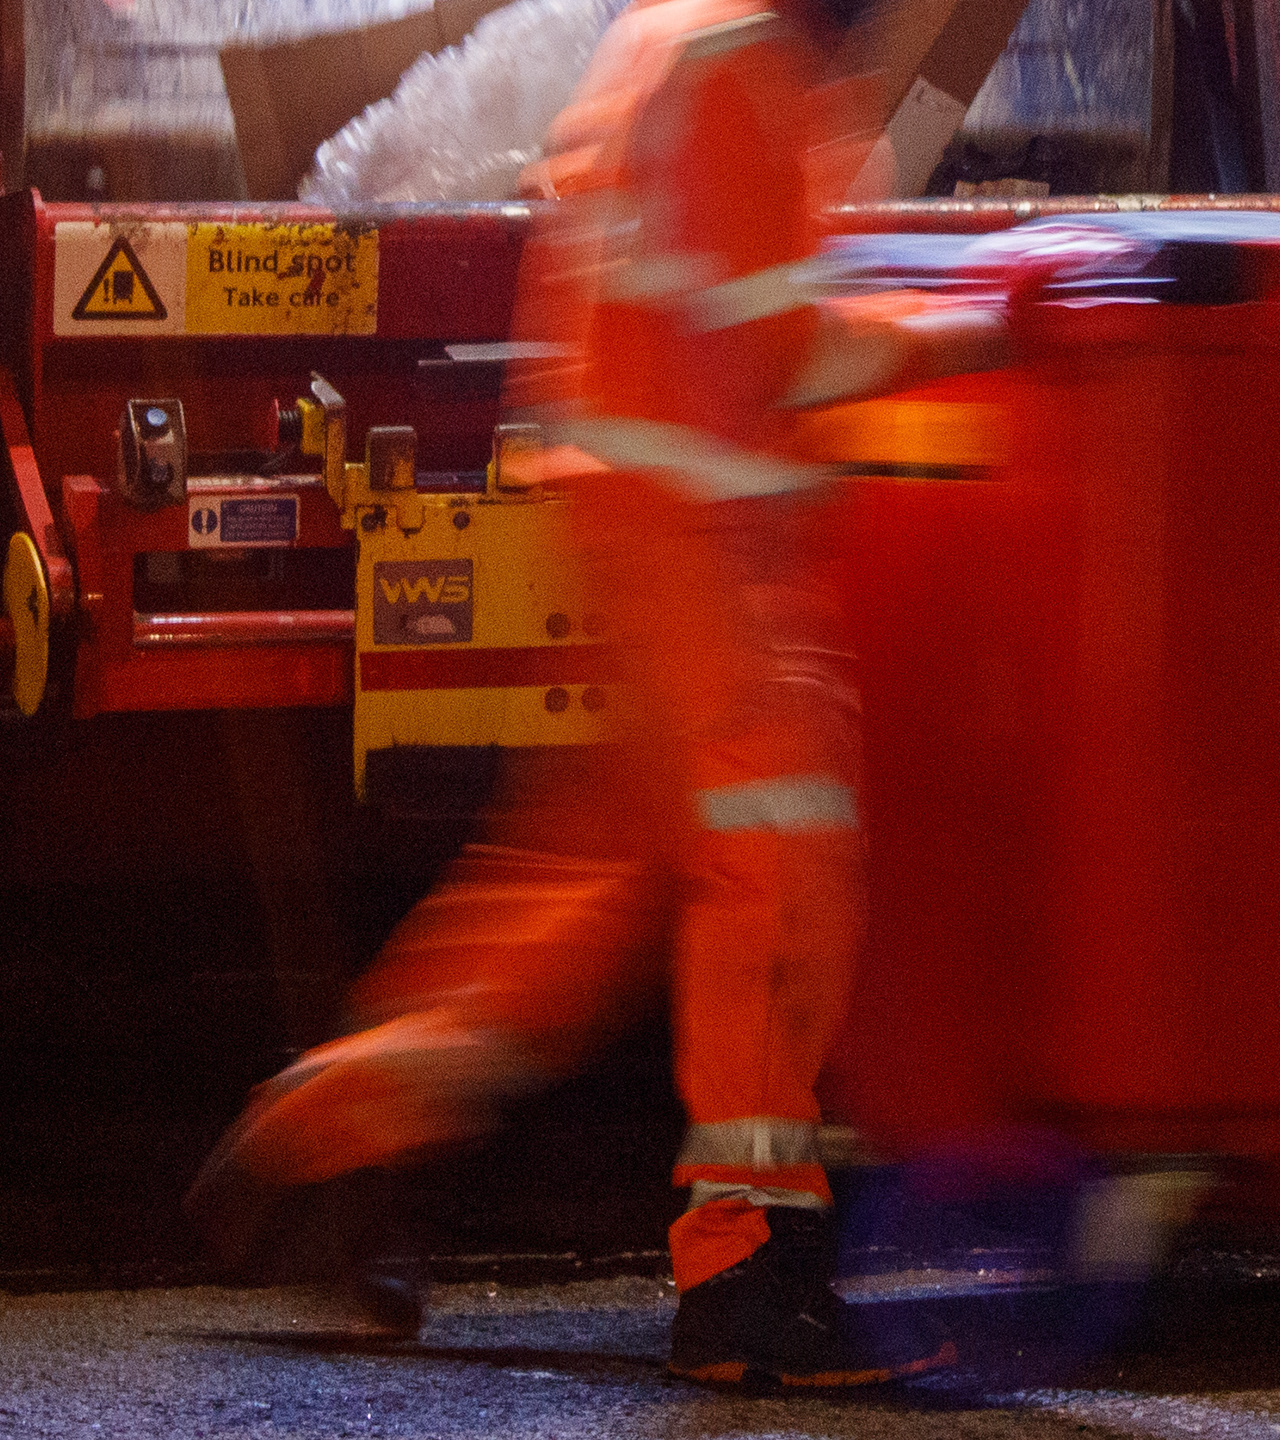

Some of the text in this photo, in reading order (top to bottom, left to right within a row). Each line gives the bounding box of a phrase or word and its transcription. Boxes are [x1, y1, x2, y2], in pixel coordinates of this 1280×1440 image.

[208, 249, 356, 278] Blind spot
[223, 286, 340, 308] Take care
